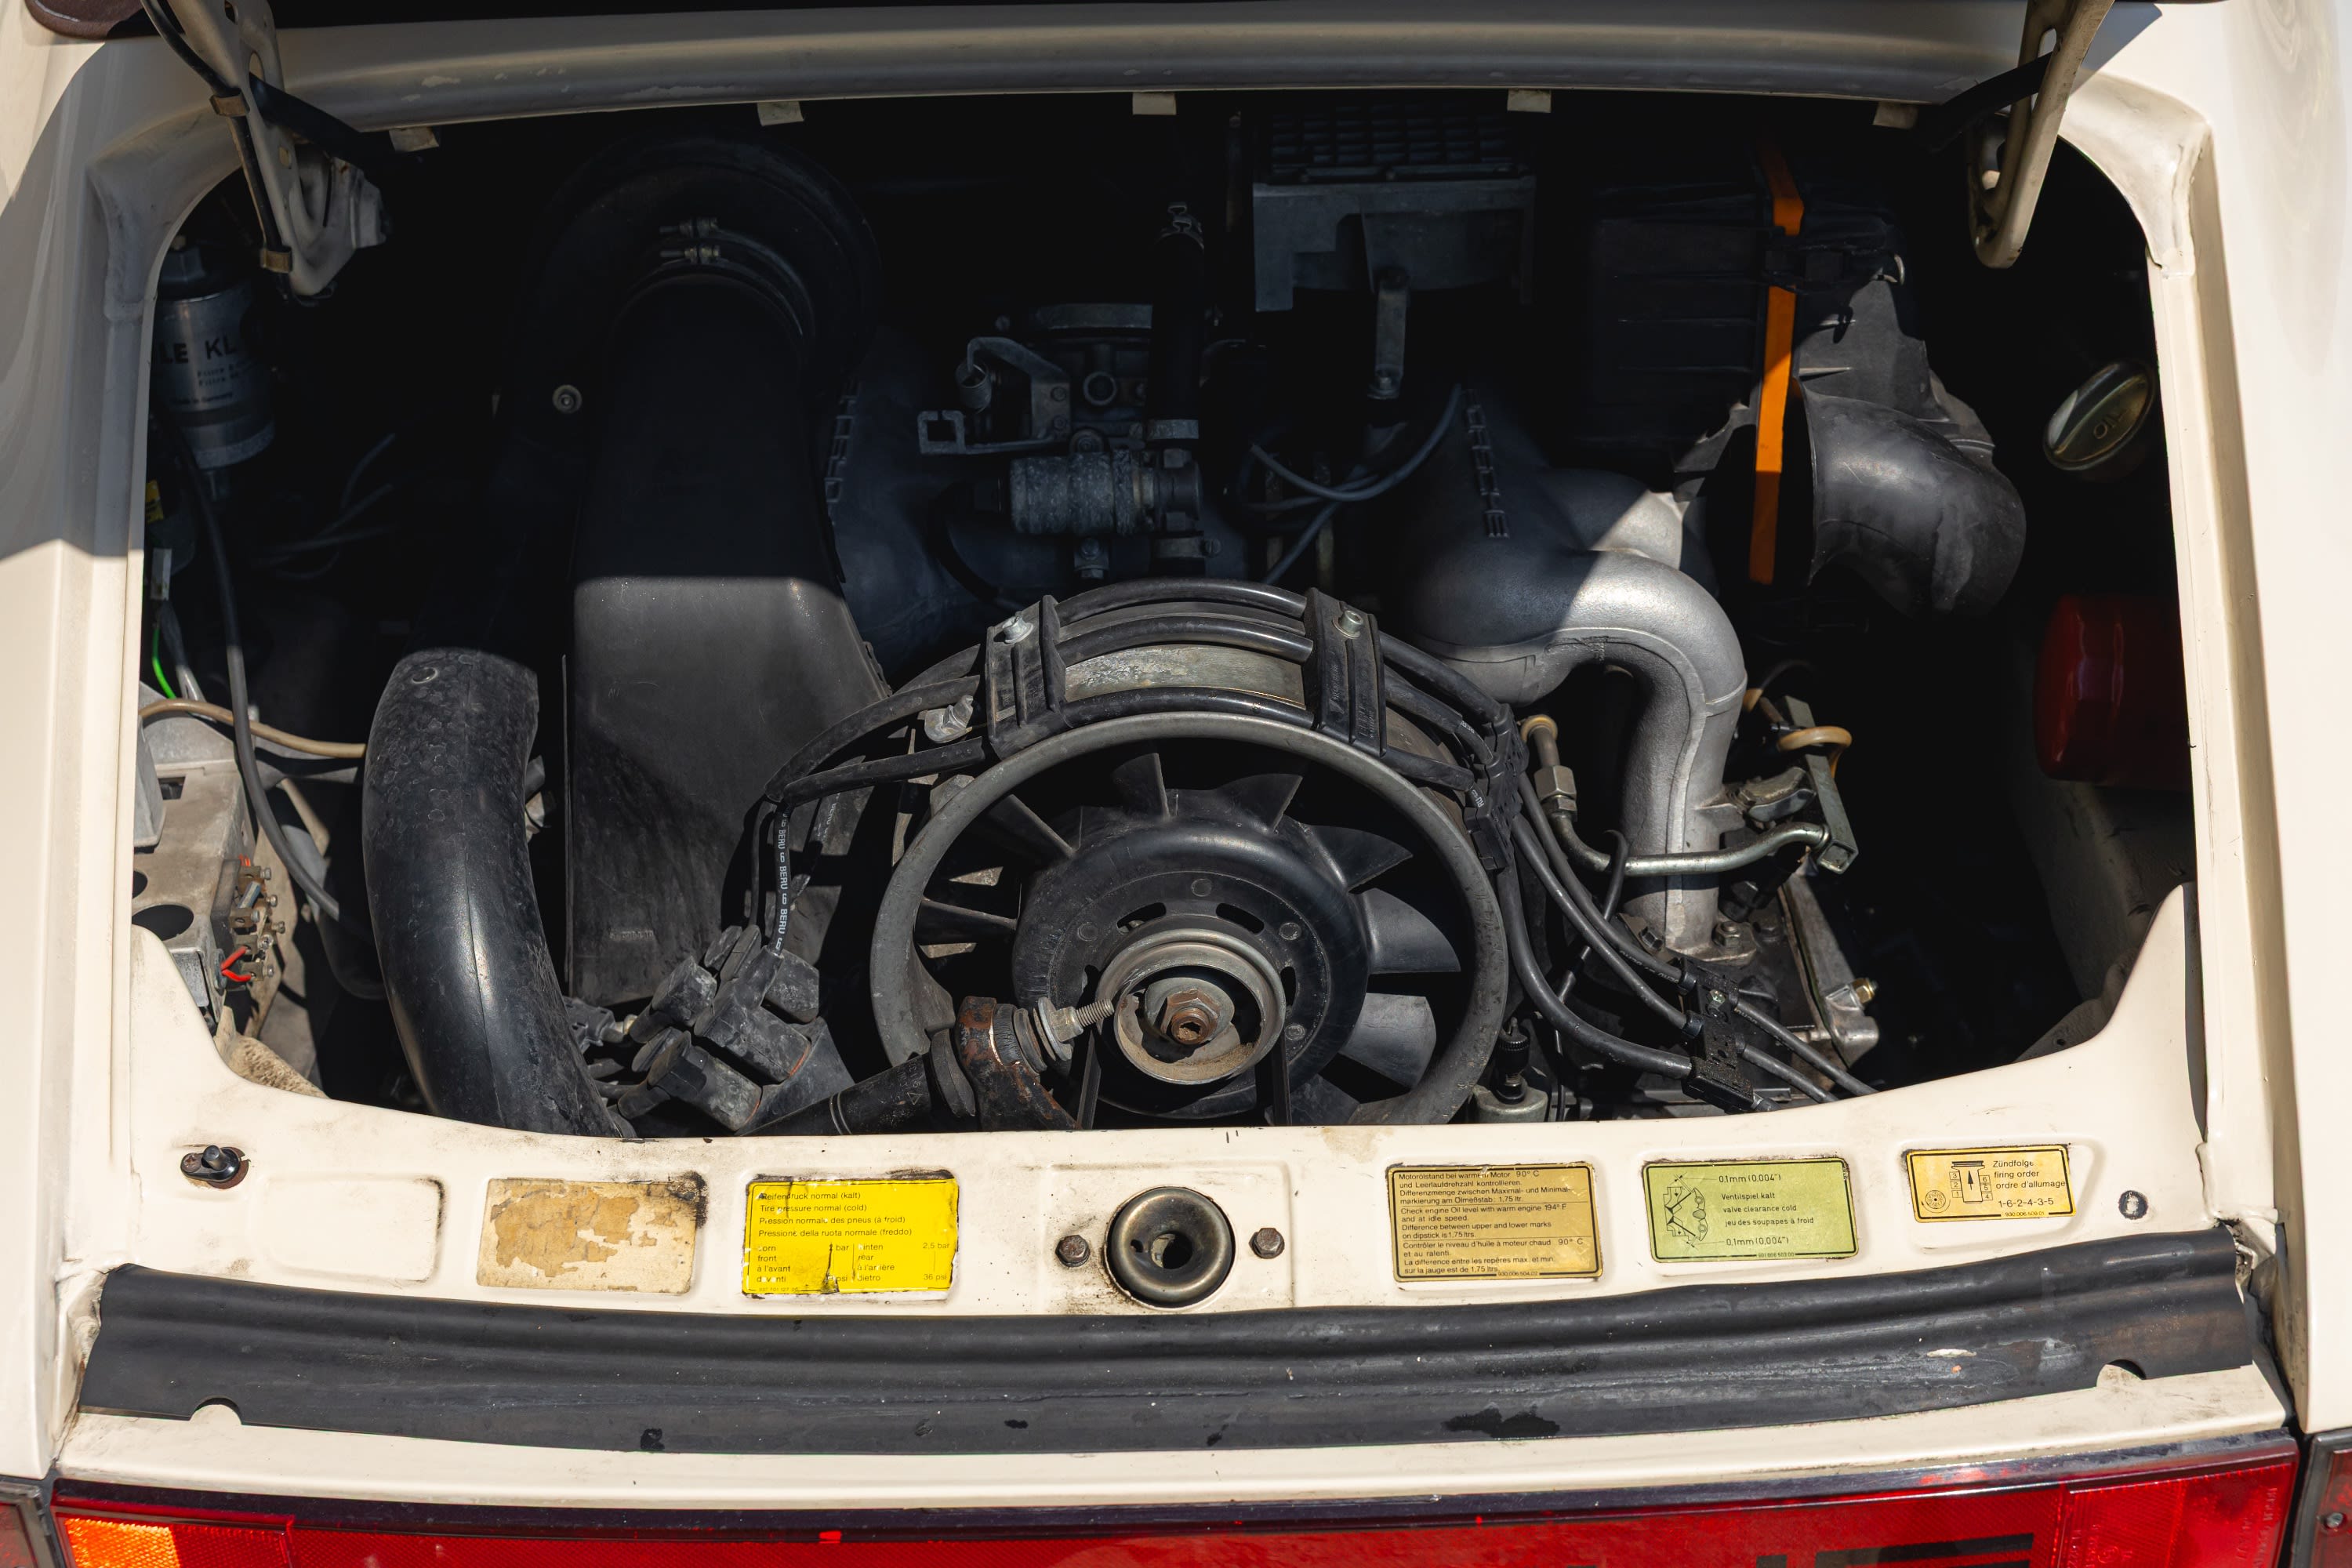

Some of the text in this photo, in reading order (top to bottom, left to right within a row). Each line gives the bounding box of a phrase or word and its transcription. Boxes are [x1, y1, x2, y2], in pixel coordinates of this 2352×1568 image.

[2093, 411, 2125, 439] OIL
[778, 829, 786, 849] BERU
[779, 866, 788, 890] BERU
[778, 909, 788, 934] BERU
[1994, 1171, 2014, 1179] firing
[1721, 1192, 1759, 1201] Ventilspiel
[1400, 1197, 1440, 1206] markierung
[1998, 1197, 2054, 1207] 1-6-2-4-3-5
[1725, 1219, 1737, 1228] jeu
[1425, 1266, 1446, 1275] jauge
